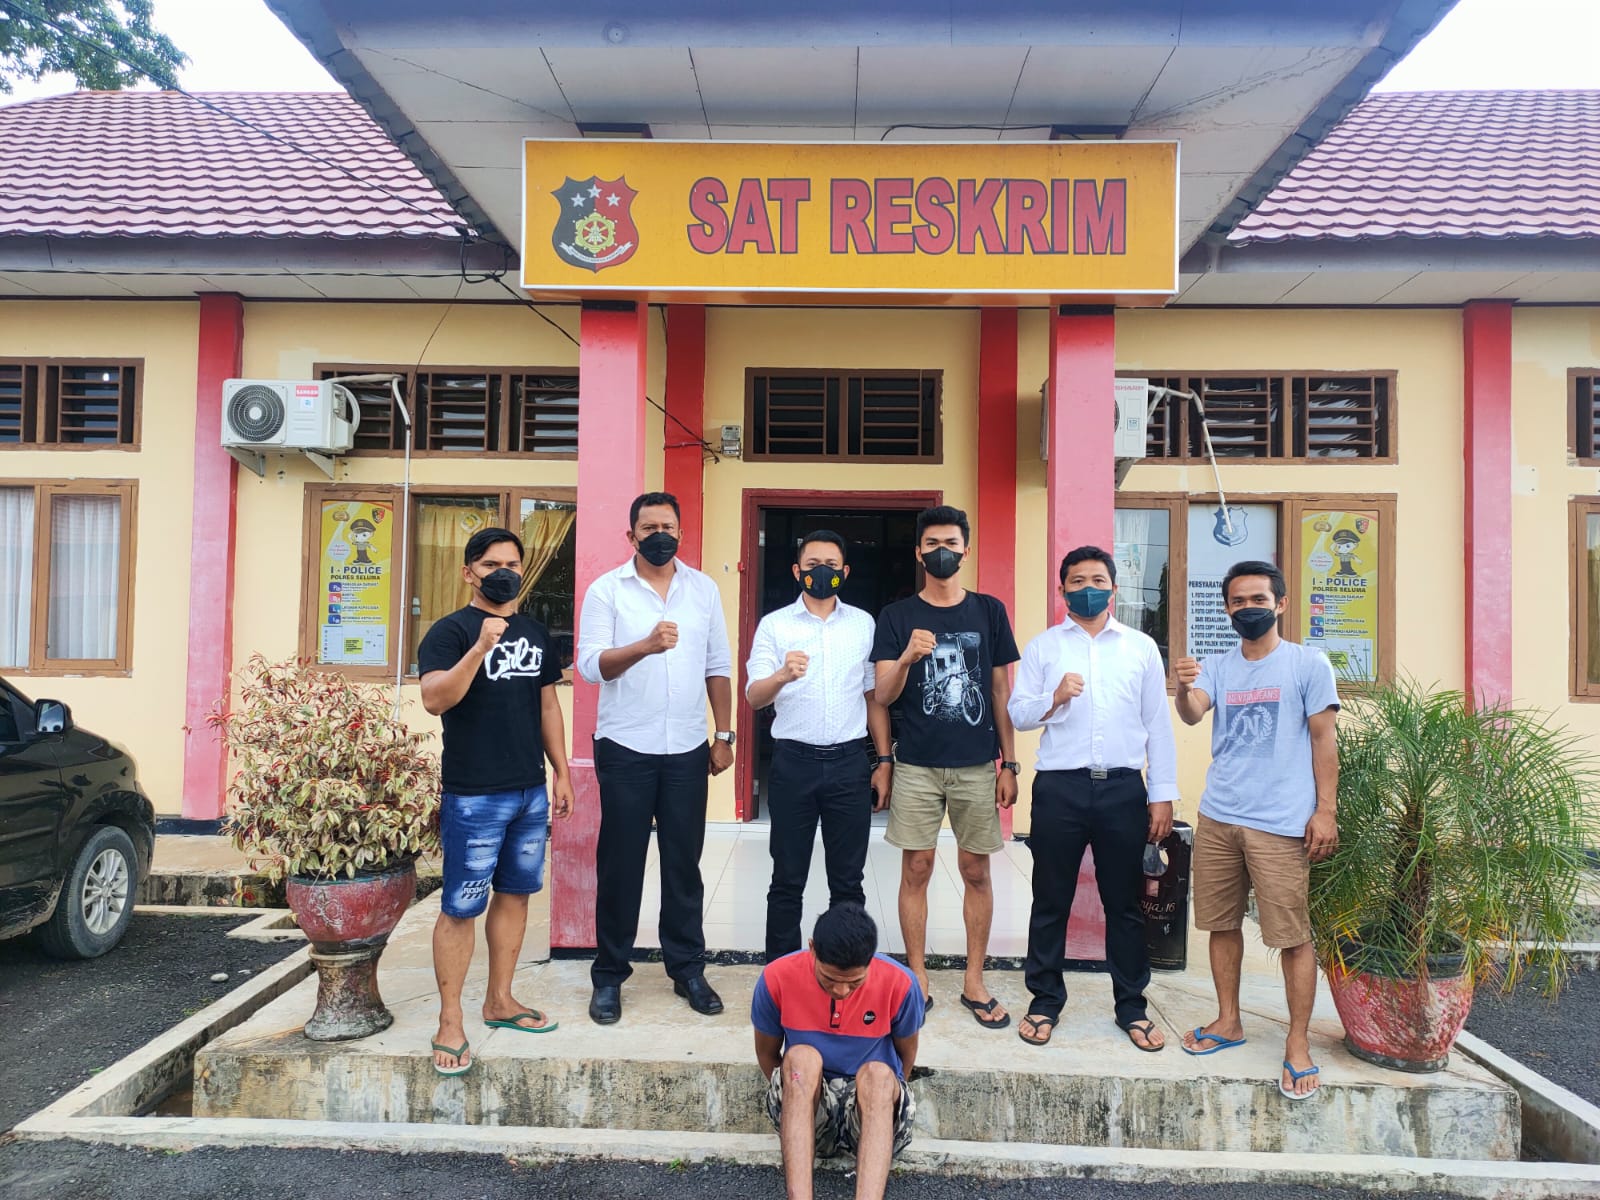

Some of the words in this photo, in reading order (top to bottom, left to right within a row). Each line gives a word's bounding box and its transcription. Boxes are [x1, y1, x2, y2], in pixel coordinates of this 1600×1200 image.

[687, 177, 811, 254] SAT
[829, 177, 1127, 255] RESKRIM
[343, 566, 382, 575] POLICE
[1188, 580, 1223, 588] PERSYARATA
[1312, 577, 1316, 586] I
[1326, 577, 1368, 587] POLICE
[1240, 714, 1262, 737] N
